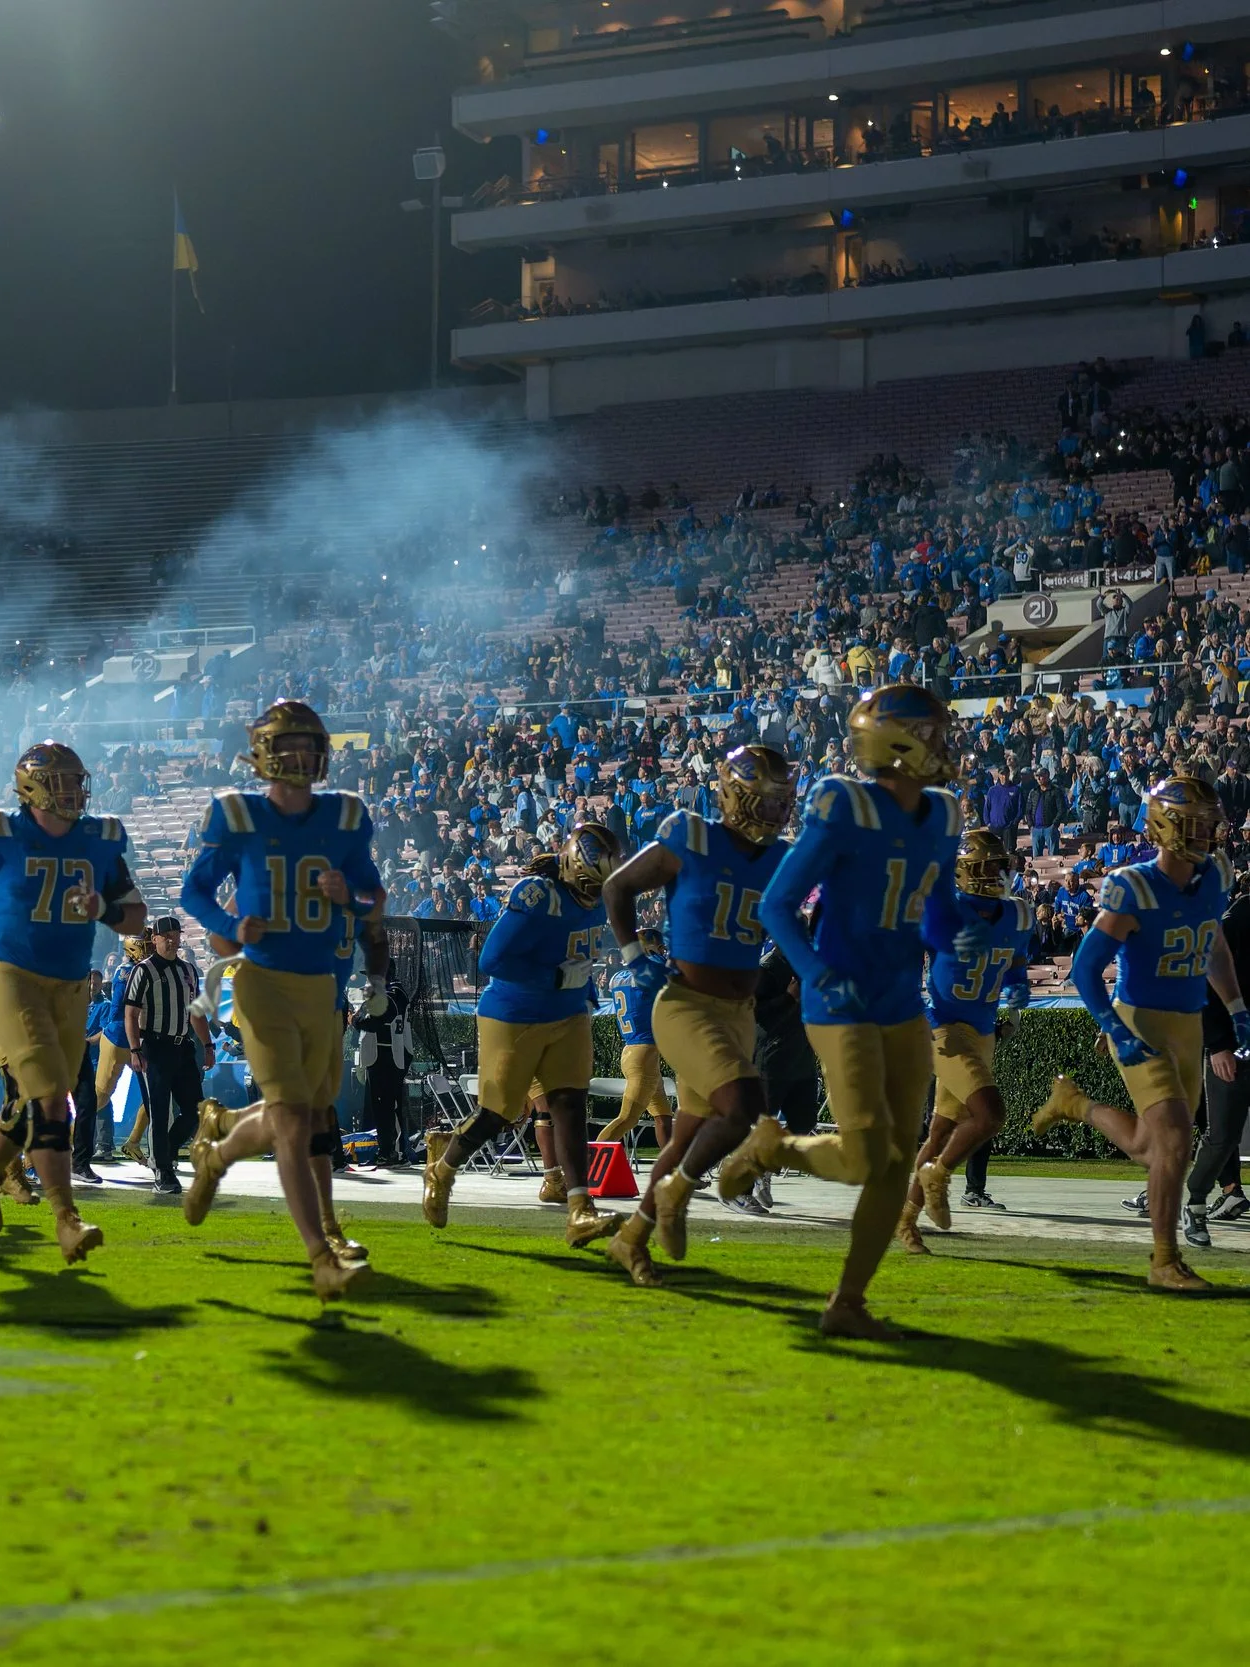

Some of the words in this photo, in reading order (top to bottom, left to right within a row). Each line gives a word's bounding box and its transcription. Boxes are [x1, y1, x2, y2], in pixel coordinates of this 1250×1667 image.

[1030, 601, 1046, 619] 21
[134, 658, 154, 674] 22
[25, 856, 95, 925] 72
[708, 880, 764, 946] 15
[878, 857, 941, 930] 14
[952, 946, 1016, 1003] 37
